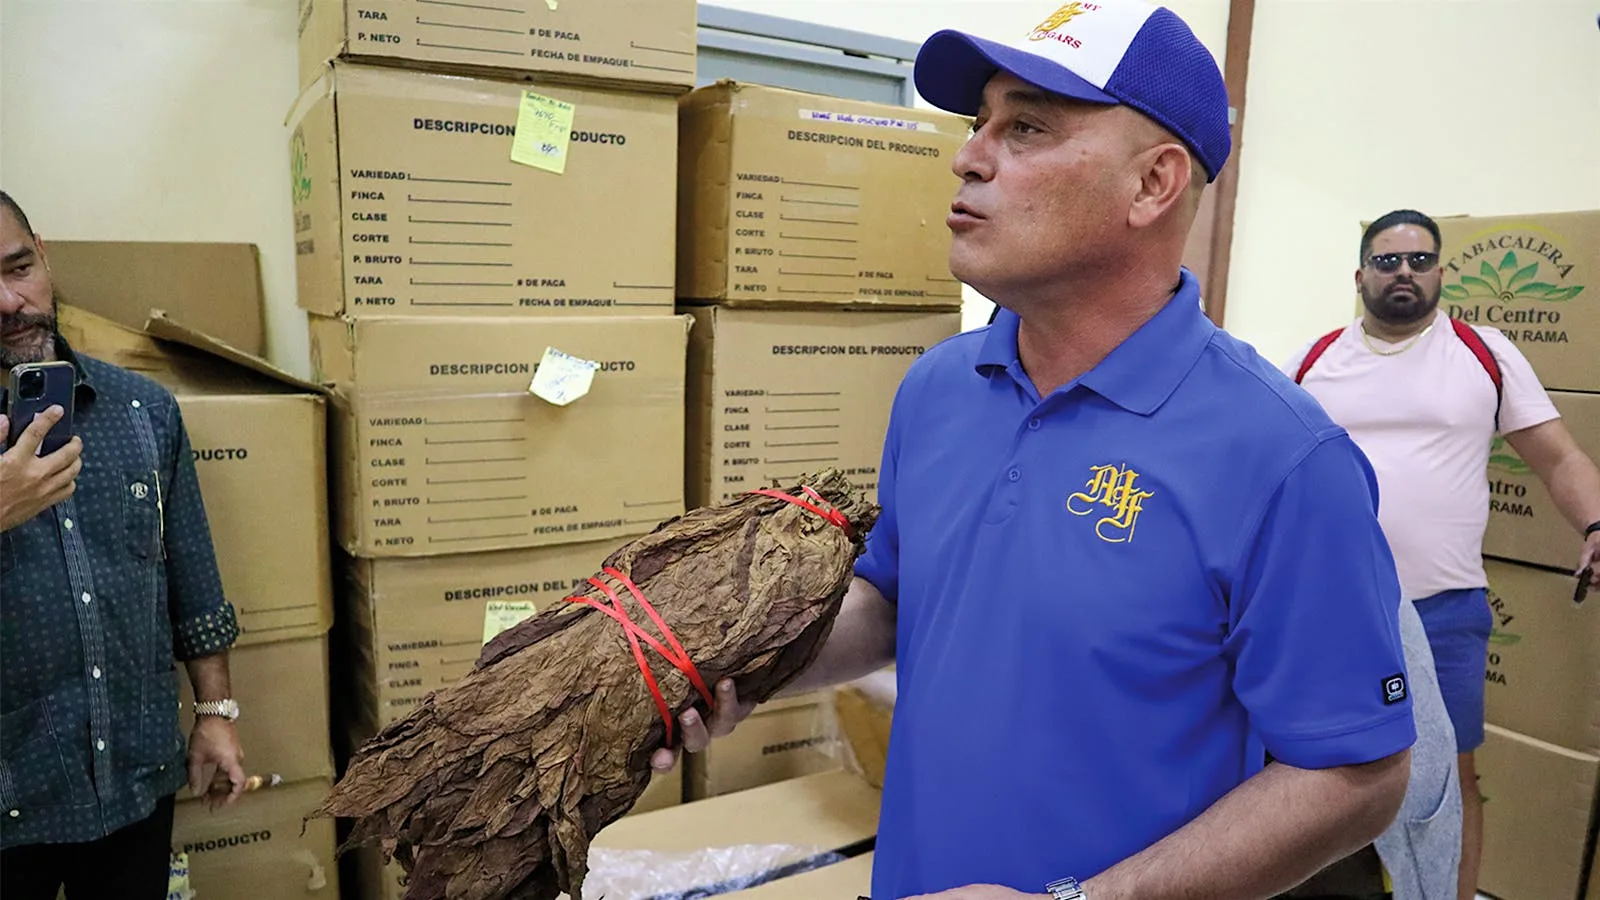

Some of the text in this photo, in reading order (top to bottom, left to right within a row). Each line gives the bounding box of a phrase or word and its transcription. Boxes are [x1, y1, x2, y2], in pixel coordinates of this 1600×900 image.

[358, 10, 387, 20] TARA
[370, 34, 400, 43] NETO
[538, 29, 551, 37] DE
[555, 31, 580, 40] PACA
[531, 49, 564, 60] FECHA
[567, 53, 580, 62] DE
[414, 118, 625, 145] DESCRIPCION ODUCTO
[788, 130, 939, 158] DESCRIPCION DEL PRODUCTO
[352, 191, 384, 200] FINCA
[736, 192, 763, 200] FINCA
[352, 213, 387, 221] CLASE
[736, 211, 764, 219] CLASE
[353, 234, 389, 243] CORTE
[365, 256, 402, 264] BRUTO
[1446, 235, 1575, 279] TABACALERA
[354, 276, 382, 284] TARA
[541, 279, 565, 287] PACA
[366, 297, 395, 305] NETO
[519, 298, 551, 308] FECHA
[554, 298, 566, 308] DE
[1449, 304, 1560, 324] Del Centro
[1523, 330, 1568, 343] RAMA
[773, 345, 925, 355] DESCRIPCION DEL PRODUCTO
[430, 363, 528, 375] DESCRIPCION
[600, 361, 635, 371] UCTO
[191, 448, 248, 461] DUCTO
[371, 458, 405, 467] CLASE
[372, 478, 407, 487] CORTE
[384, 497, 420, 507] BRUTO
[1490, 500, 1533, 517] RAMA
[374, 518, 401, 526] TARA
[534, 526, 564, 534] FECHA
[386, 537, 414, 545] NETO
[445, 584, 538, 601] DESCRIPCION
[543, 580, 567, 591] DEL
[182, 830, 271, 854] PRODUCTO
